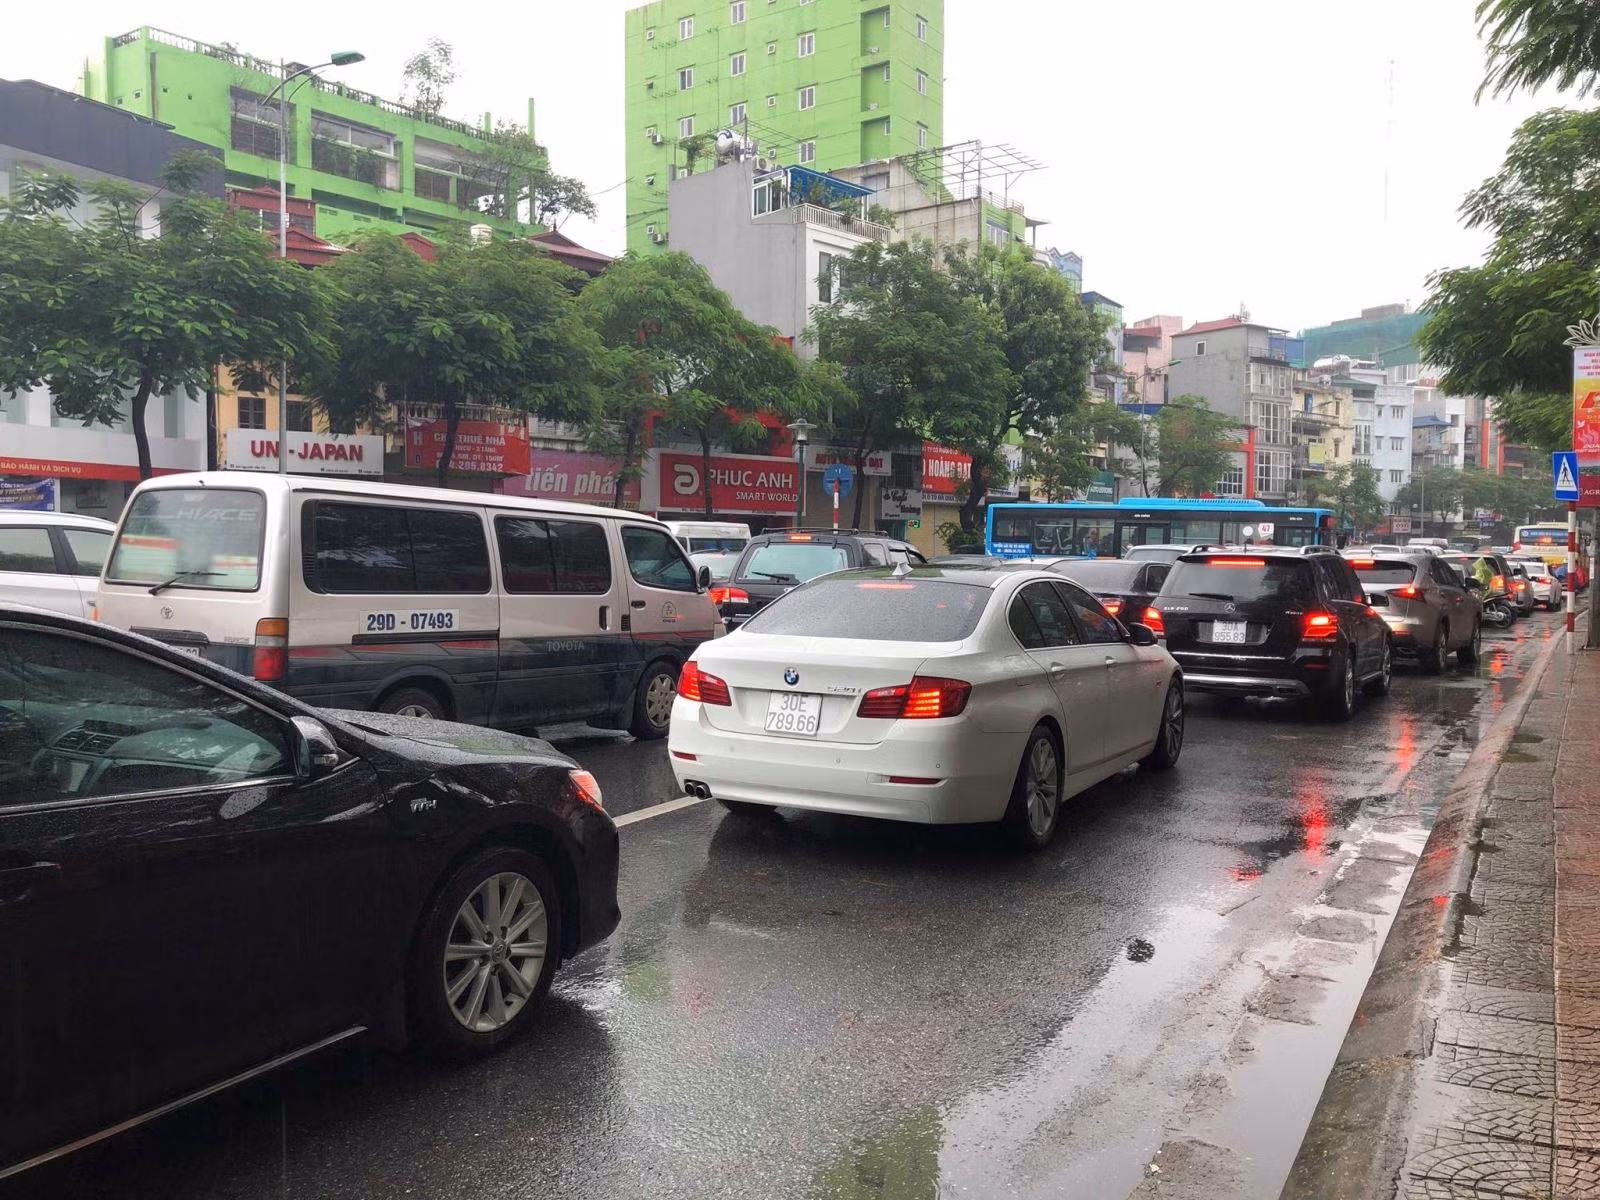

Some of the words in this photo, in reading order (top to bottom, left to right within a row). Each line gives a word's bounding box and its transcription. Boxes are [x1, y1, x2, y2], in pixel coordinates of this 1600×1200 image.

[298, 443, 363, 462] JAPAN
[525, 464, 569, 492] tiến
[756, 472, 793, 488] ANH
[736, 491, 766, 501] SMART
[767, 493, 799, 502] WORLD
[176, 508, 258, 521] HIACE
[1262, 525, 1271, 533] 47
[367, 613, 396, 631] 29D
[410, 612, 453, 630] 07493
[1214, 631, 1245, 642] 955.83
[546, 641, 585, 651] TOYOTA
[781, 693, 806, 712] 30E
[766, 711, 815, 732] 789.66
